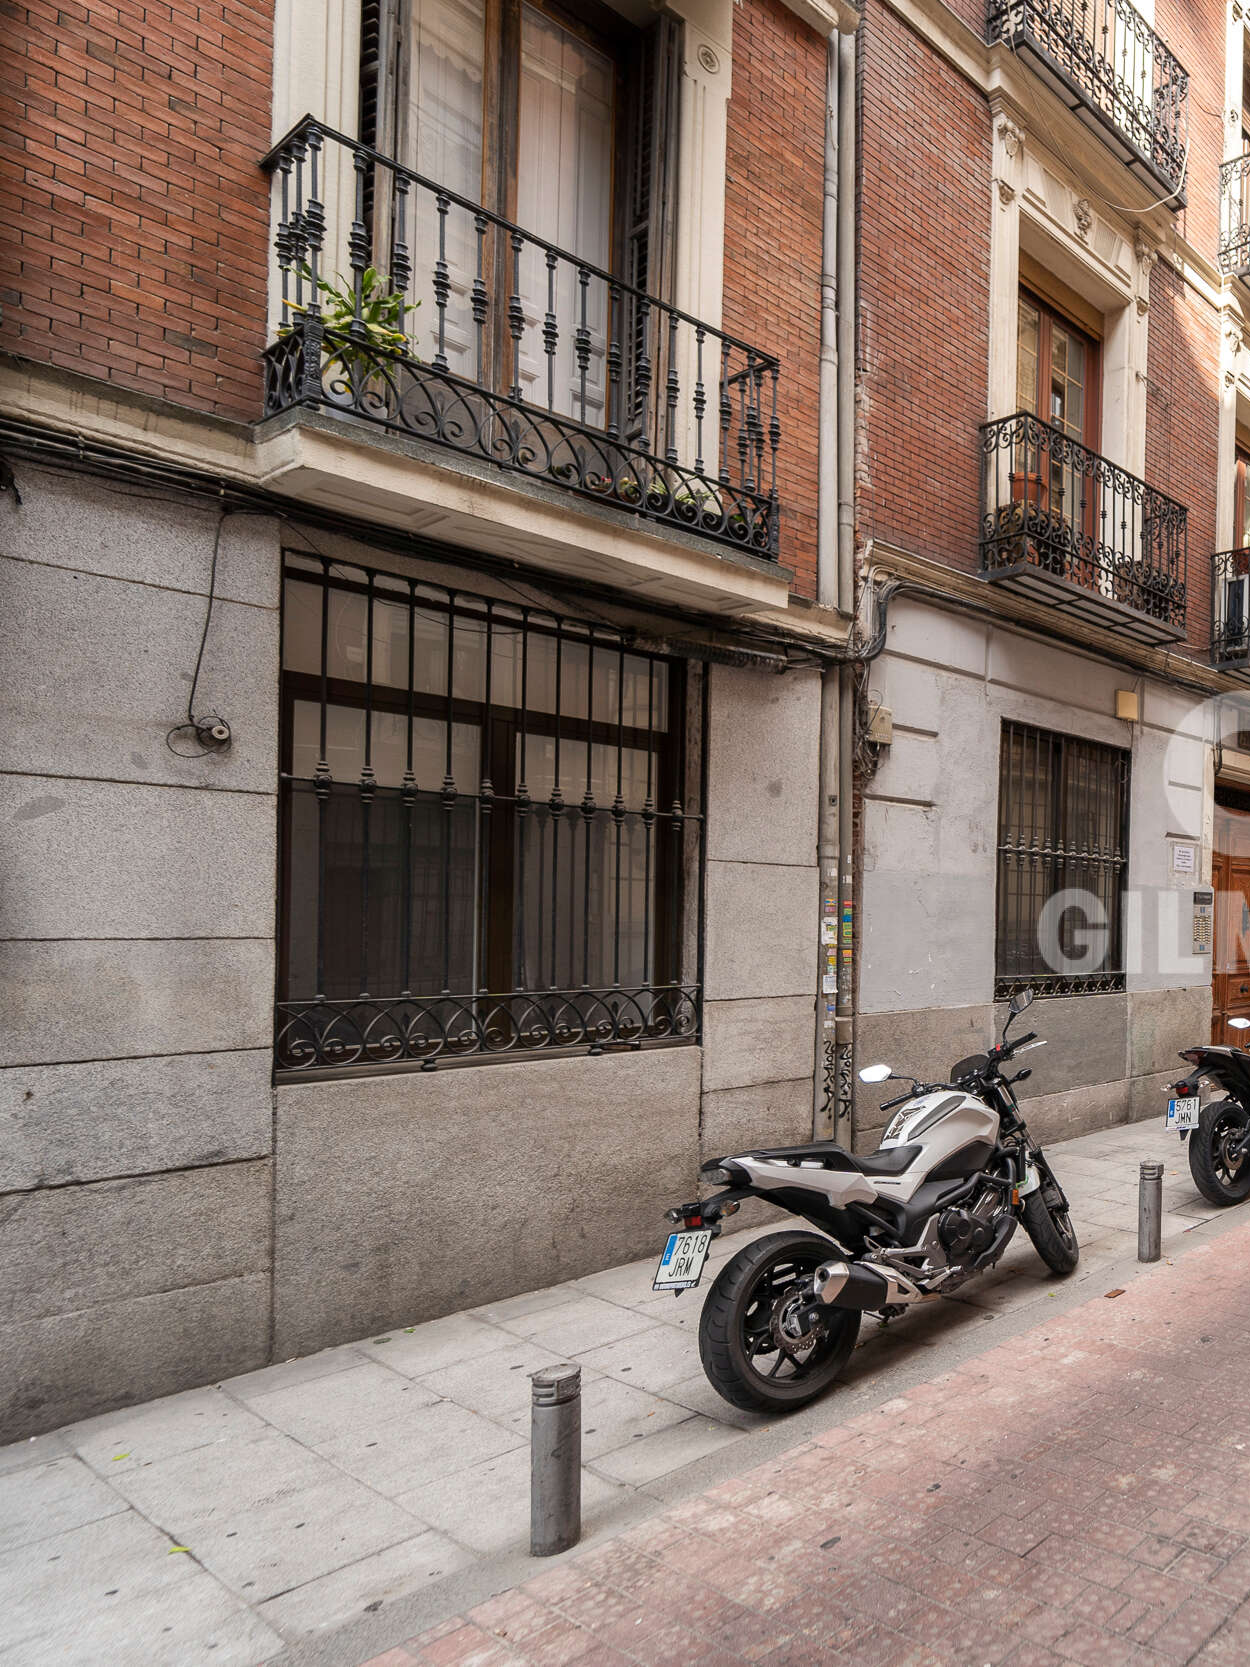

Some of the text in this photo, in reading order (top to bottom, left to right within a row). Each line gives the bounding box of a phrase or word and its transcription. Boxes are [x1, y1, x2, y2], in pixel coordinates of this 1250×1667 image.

[1175, 1099, 1196, 1111] 5761
[1175, 1112, 1192, 1124] JHN
[674, 1234, 708, 1256] 7618
[668, 1256, 694, 1277] JRM
